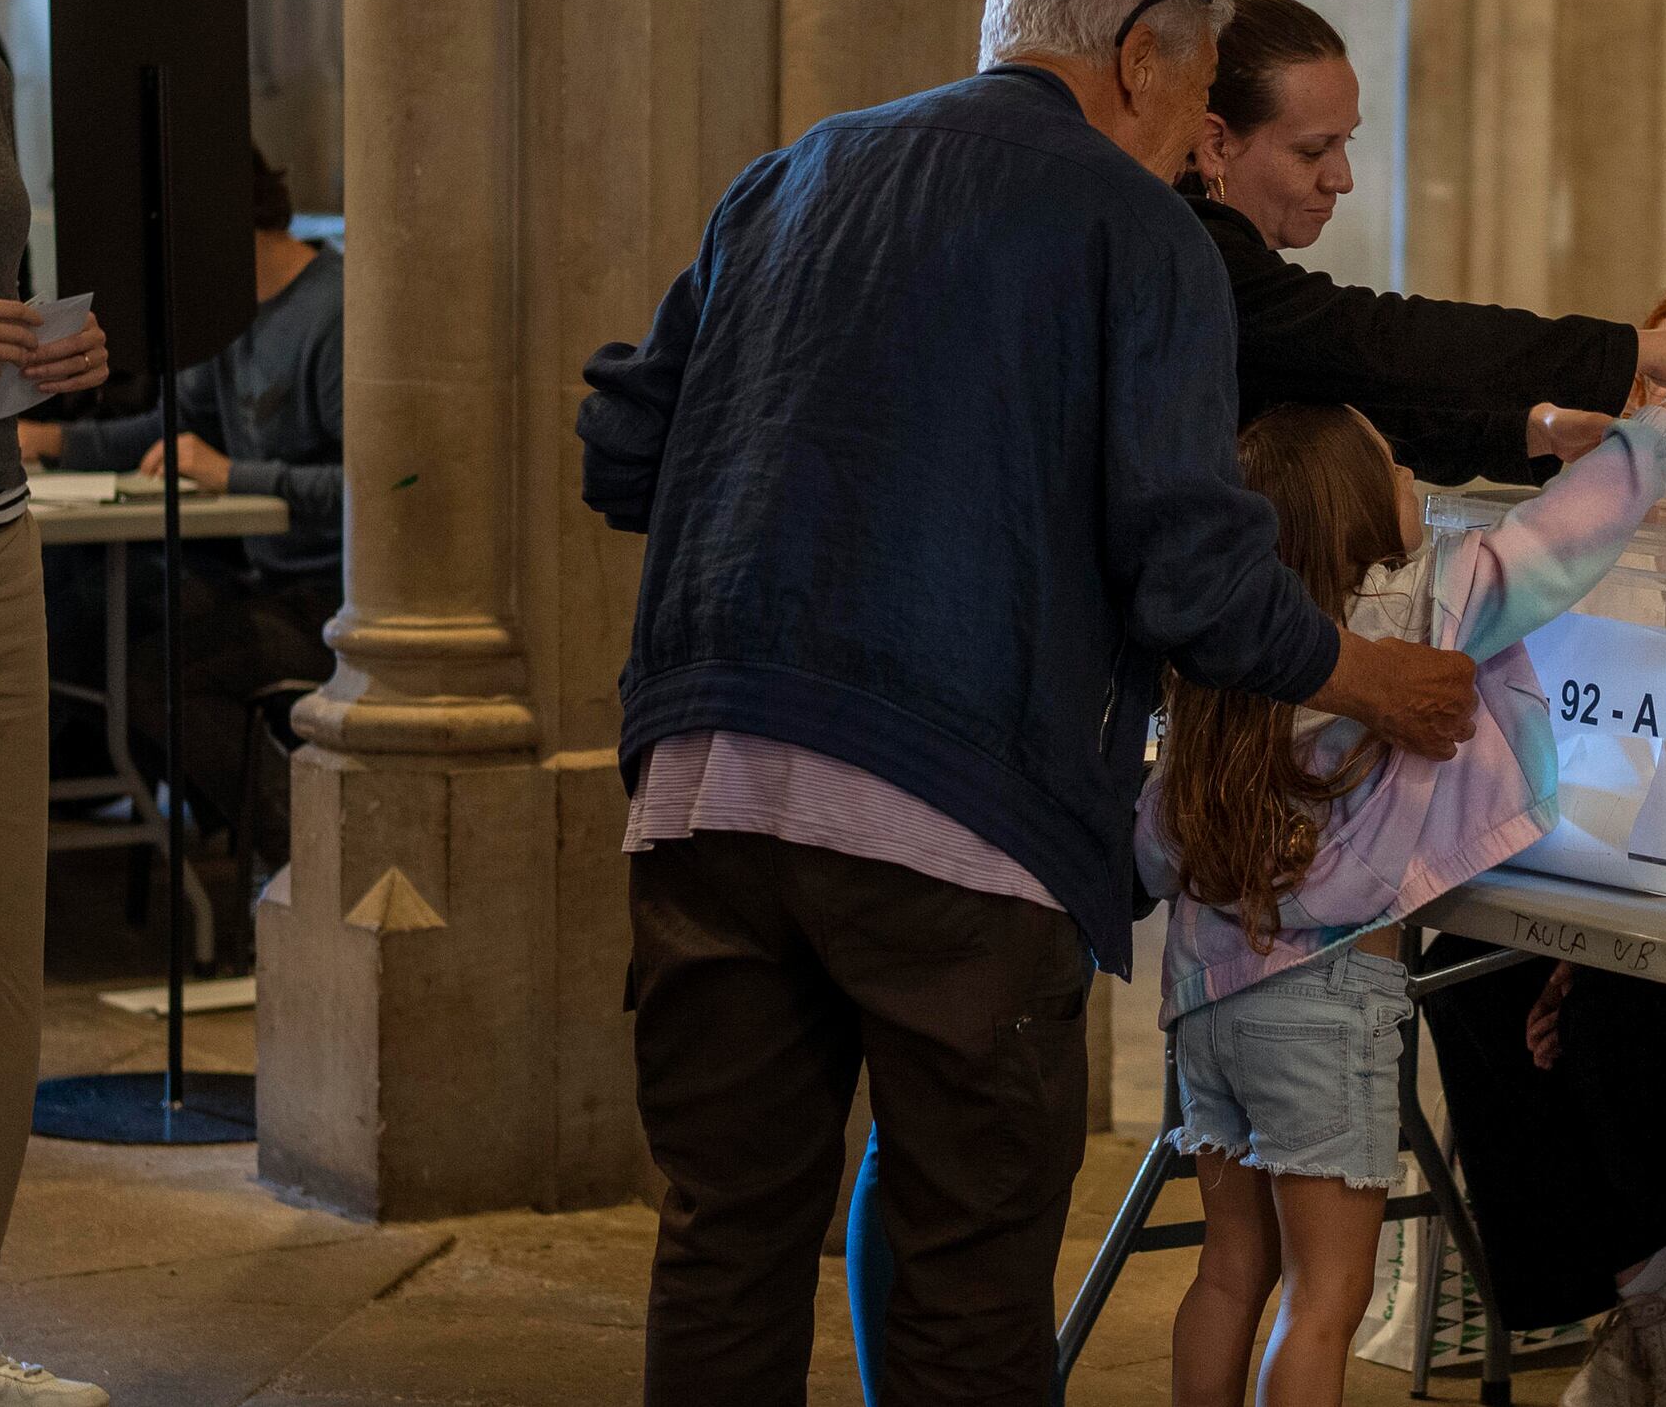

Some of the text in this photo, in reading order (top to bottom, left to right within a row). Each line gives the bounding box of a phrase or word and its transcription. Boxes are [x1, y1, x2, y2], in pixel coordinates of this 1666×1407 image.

[1560, 679, 1601, 726] 92
[1631, 693, 1659, 737] A
[1508, 910, 1587, 955] TAULA
